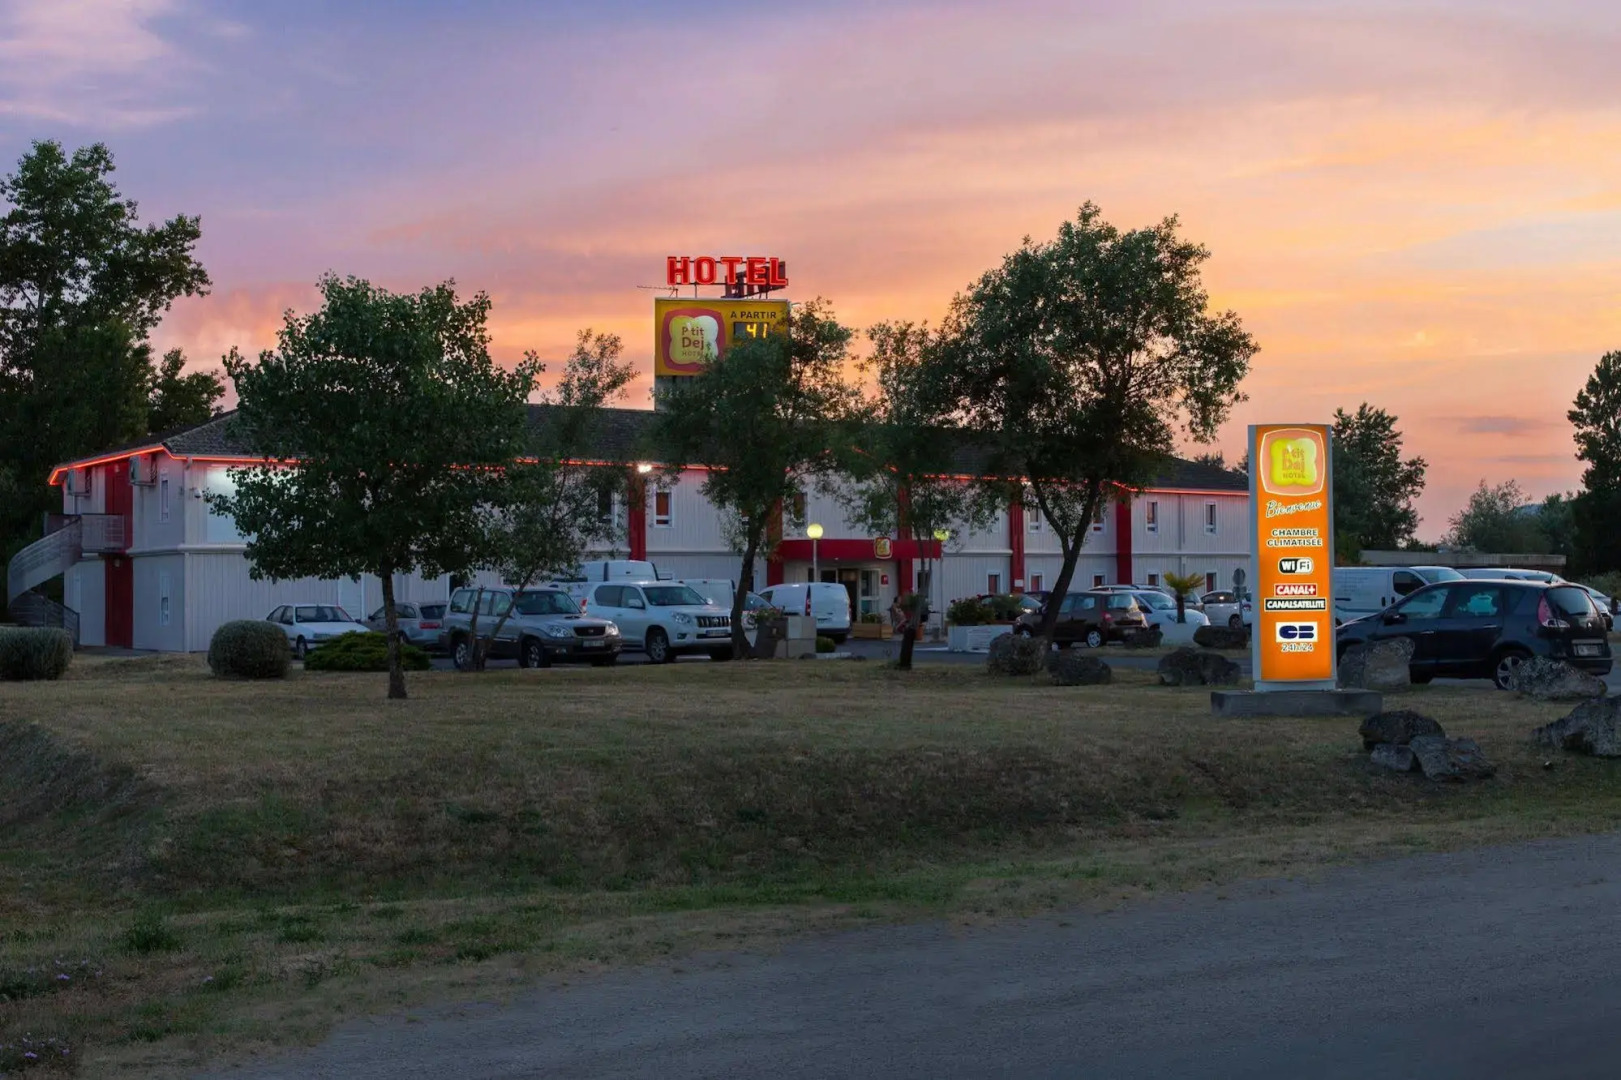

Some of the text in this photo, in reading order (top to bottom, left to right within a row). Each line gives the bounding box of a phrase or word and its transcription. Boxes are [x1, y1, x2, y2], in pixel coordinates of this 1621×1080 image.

[667, 256, 788, 286] HOTEL
[740, 311, 777, 319] PARTIR
[1266, 500, 1322, 518] Bienvenue
[1276, 585, 1316, 595] CANAL+
[1267, 600, 1325, 609] CANALSATELLITE
